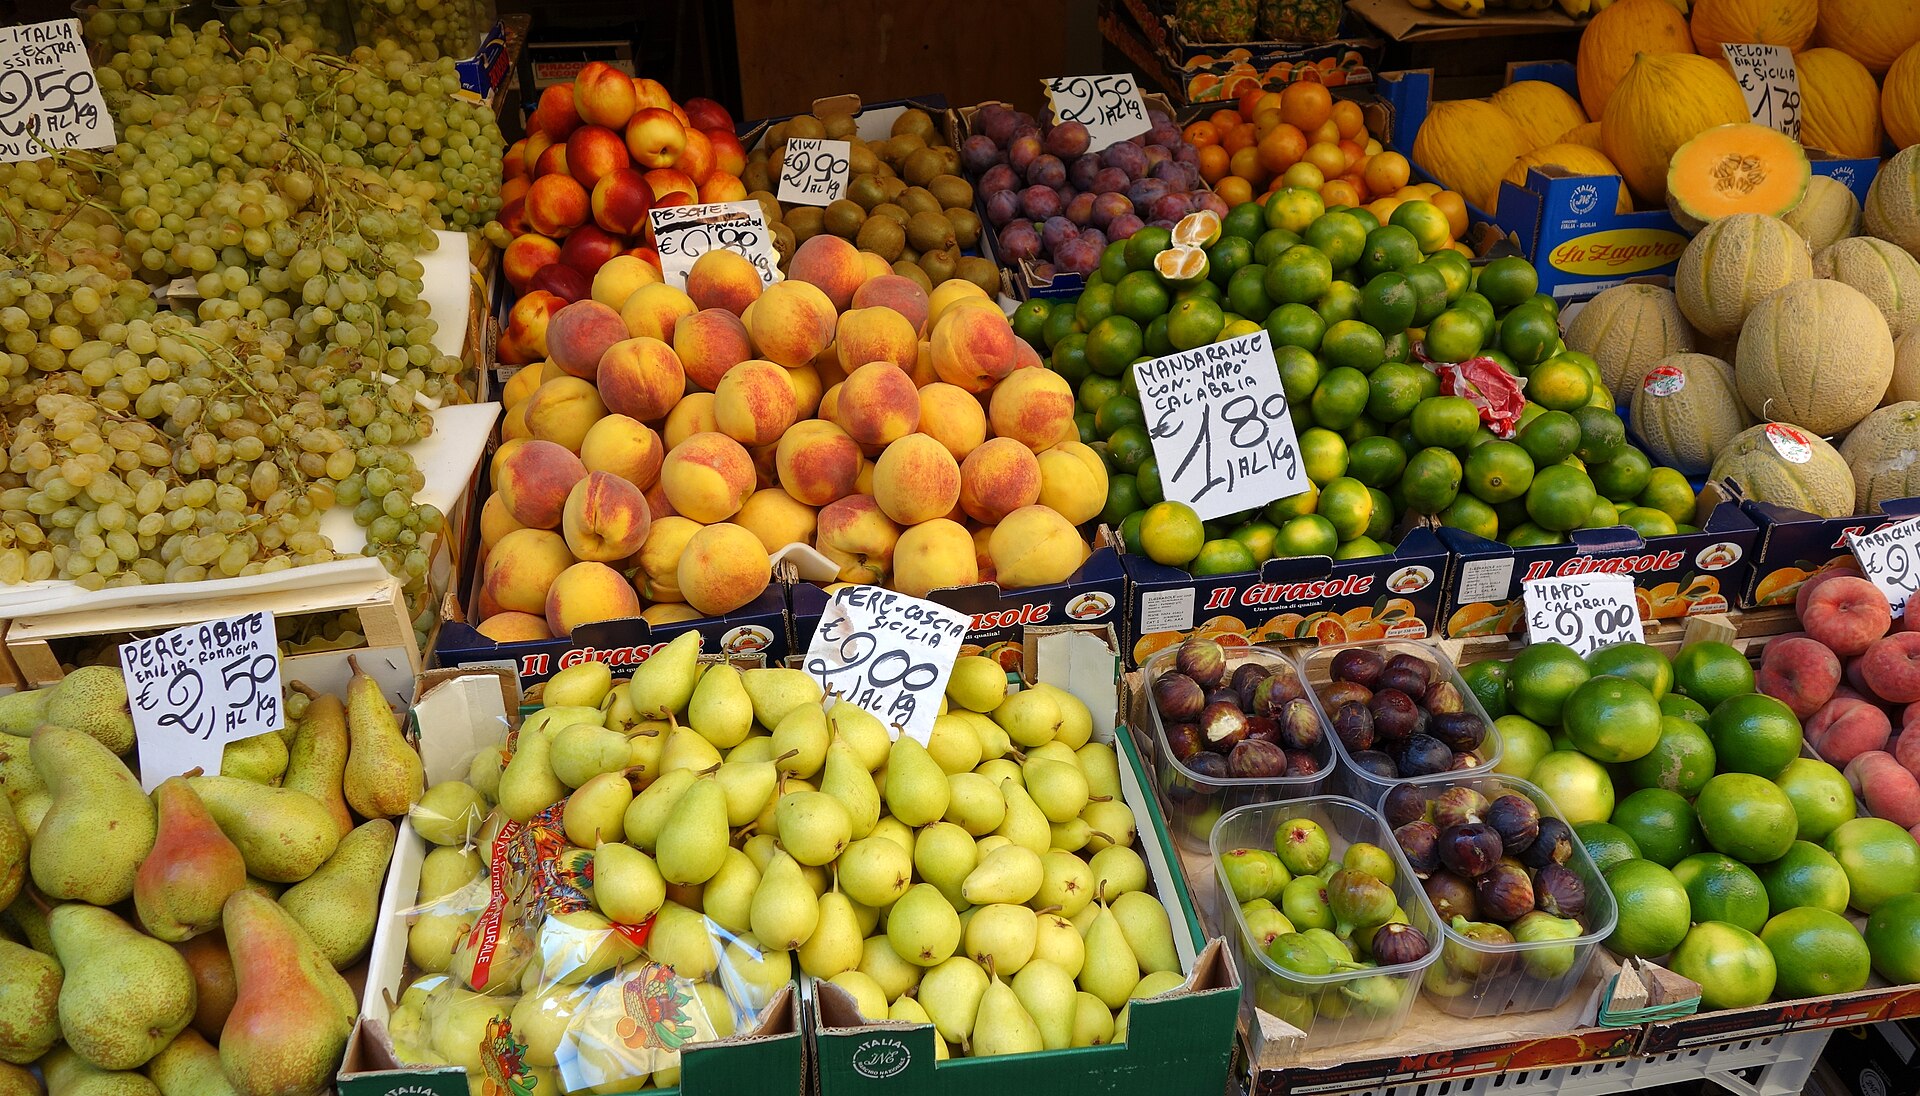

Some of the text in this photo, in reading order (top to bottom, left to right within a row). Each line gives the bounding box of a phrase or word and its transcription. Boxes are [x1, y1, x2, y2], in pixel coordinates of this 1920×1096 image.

[13, 23, 73, 42] ITALIA
[1754, 67, 1795, 83] SICILIA
[790, 139, 822, 151] KIWI
[1574, 184, 1597, 195] ITALIA
[1588, 241, 1681, 266] Zagara
[1156, 376, 1256, 410] CALABRIA
[1520, 560, 1553, 583] Il
[1555, 550, 1685, 578] Girasole
[1203, 587, 1236, 610] Il
[1241, 574, 1374, 607] Girasole
[967, 603, 1050, 632] asole
[868, 616, 942, 648] SICILIA
[520, 653, 549, 677] Il
[859, 1038, 902, 1051] ITALIA
[1396, 1050, 1455, 1073] MG
